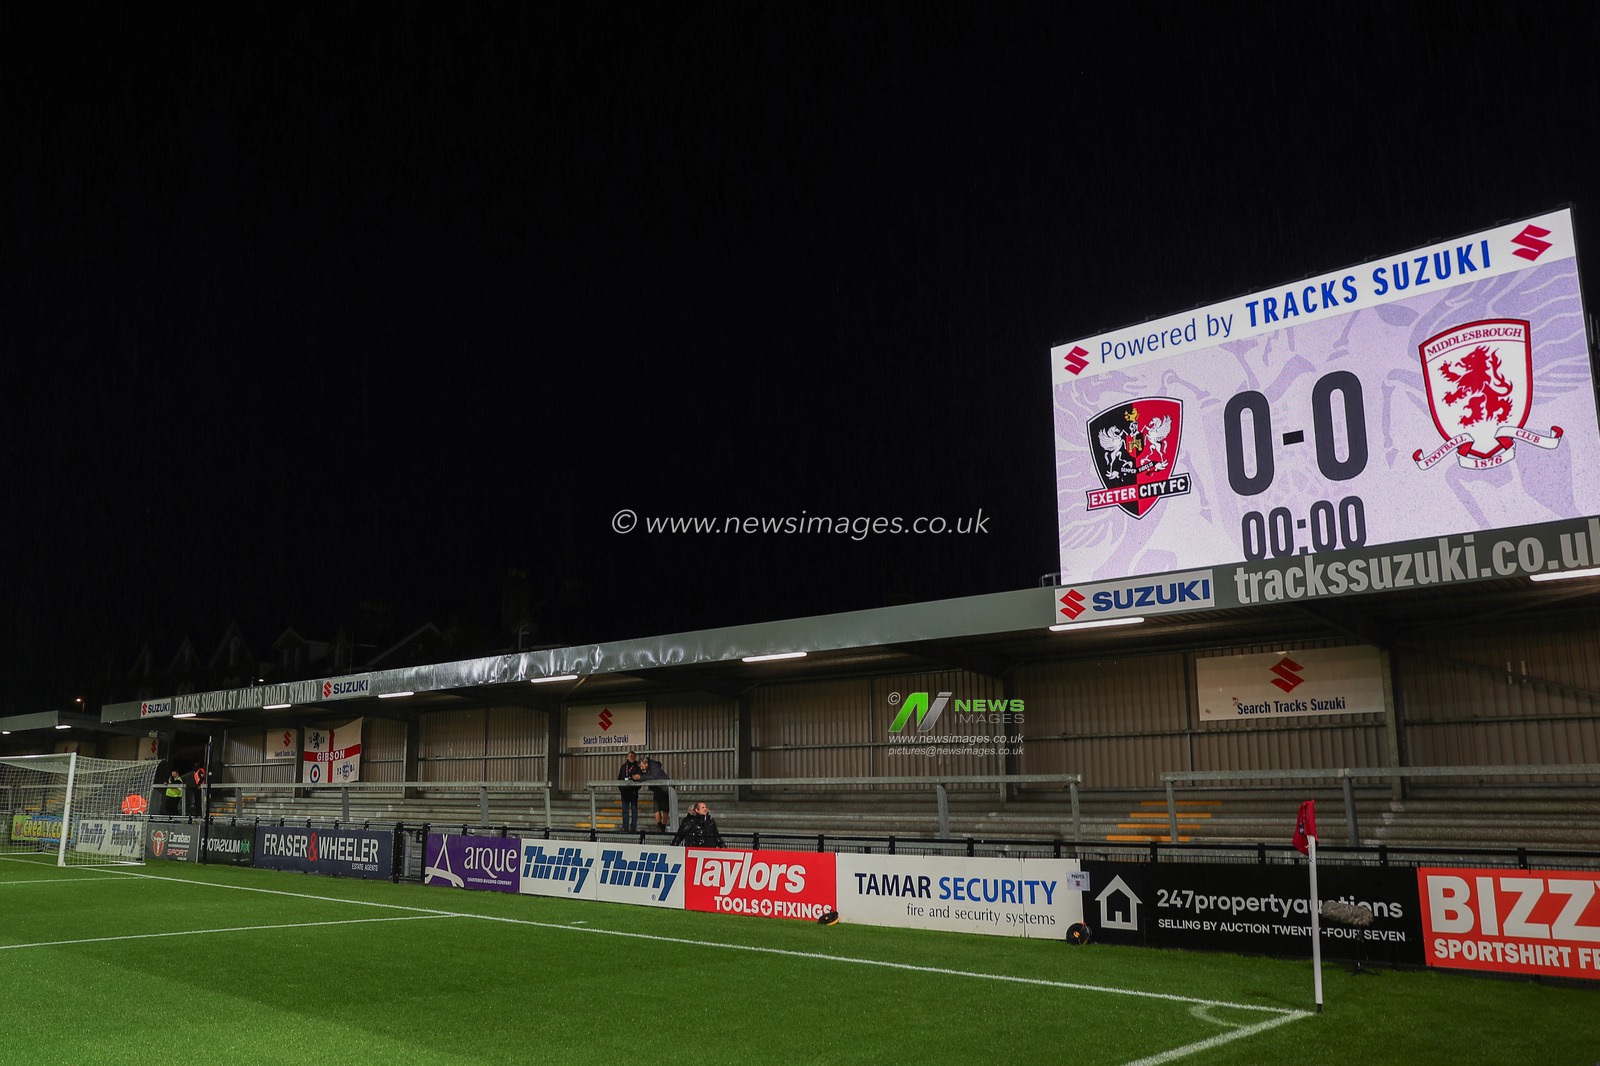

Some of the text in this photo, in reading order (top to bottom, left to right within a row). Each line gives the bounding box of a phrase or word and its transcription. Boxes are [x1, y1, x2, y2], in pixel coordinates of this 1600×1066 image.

[1101, 240, 1491, 363] Powered by TRACKS SUZUKI
[1427, 328, 1522, 356] MIDDLESBROUGH
[1515, 429, 1541, 443] CLUB
[1424, 436, 1467, 467] FOOTBALL
[1474, 456, 1503, 468] 1876
[1091, 478, 1186, 506] EXETER CITY FC
[1241, 495, 1367, 561] 00:00
[1092, 579, 1210, 612] SUZUKI
[175, 681, 317, 714] TRACKS SUZUKI ST JAMES ROAD STAND
[333, 680, 369, 694] SUZUKI
[148, 702, 171, 713] SUZUKI
[1237, 696, 1346, 715] Search Tracks Suzuki
[583, 734, 629, 745] Search Tracks Suzuki
[317, 749, 345, 761] GIBSON
[169, 832, 191, 843] Carabao
[263, 833, 308, 857] FRASER
[319, 836, 379, 863] WHEELER
[167, 848, 189, 856] SPORT
[352, 863, 364, 871] ESTATE
[523, 845, 594, 893] Thrifty
[600, 850, 682, 901] Thrifty
[687, 850, 806, 896] Taylors
[855, 872, 1057, 905] TAMAR SECURITY
[714, 896, 832, 919] TOOLS FIXINGS
[907, 903, 1056, 926] fire and security systems
[1157, 889, 1403, 918] 247propertyautins
[1426, 875, 1600, 942] BIZZ
[1158, 918, 1406, 942] SELLING BY AUCTION TWENT-FOUR SEVEN
[1434, 938, 1571, 968] SPORTSHIRT
